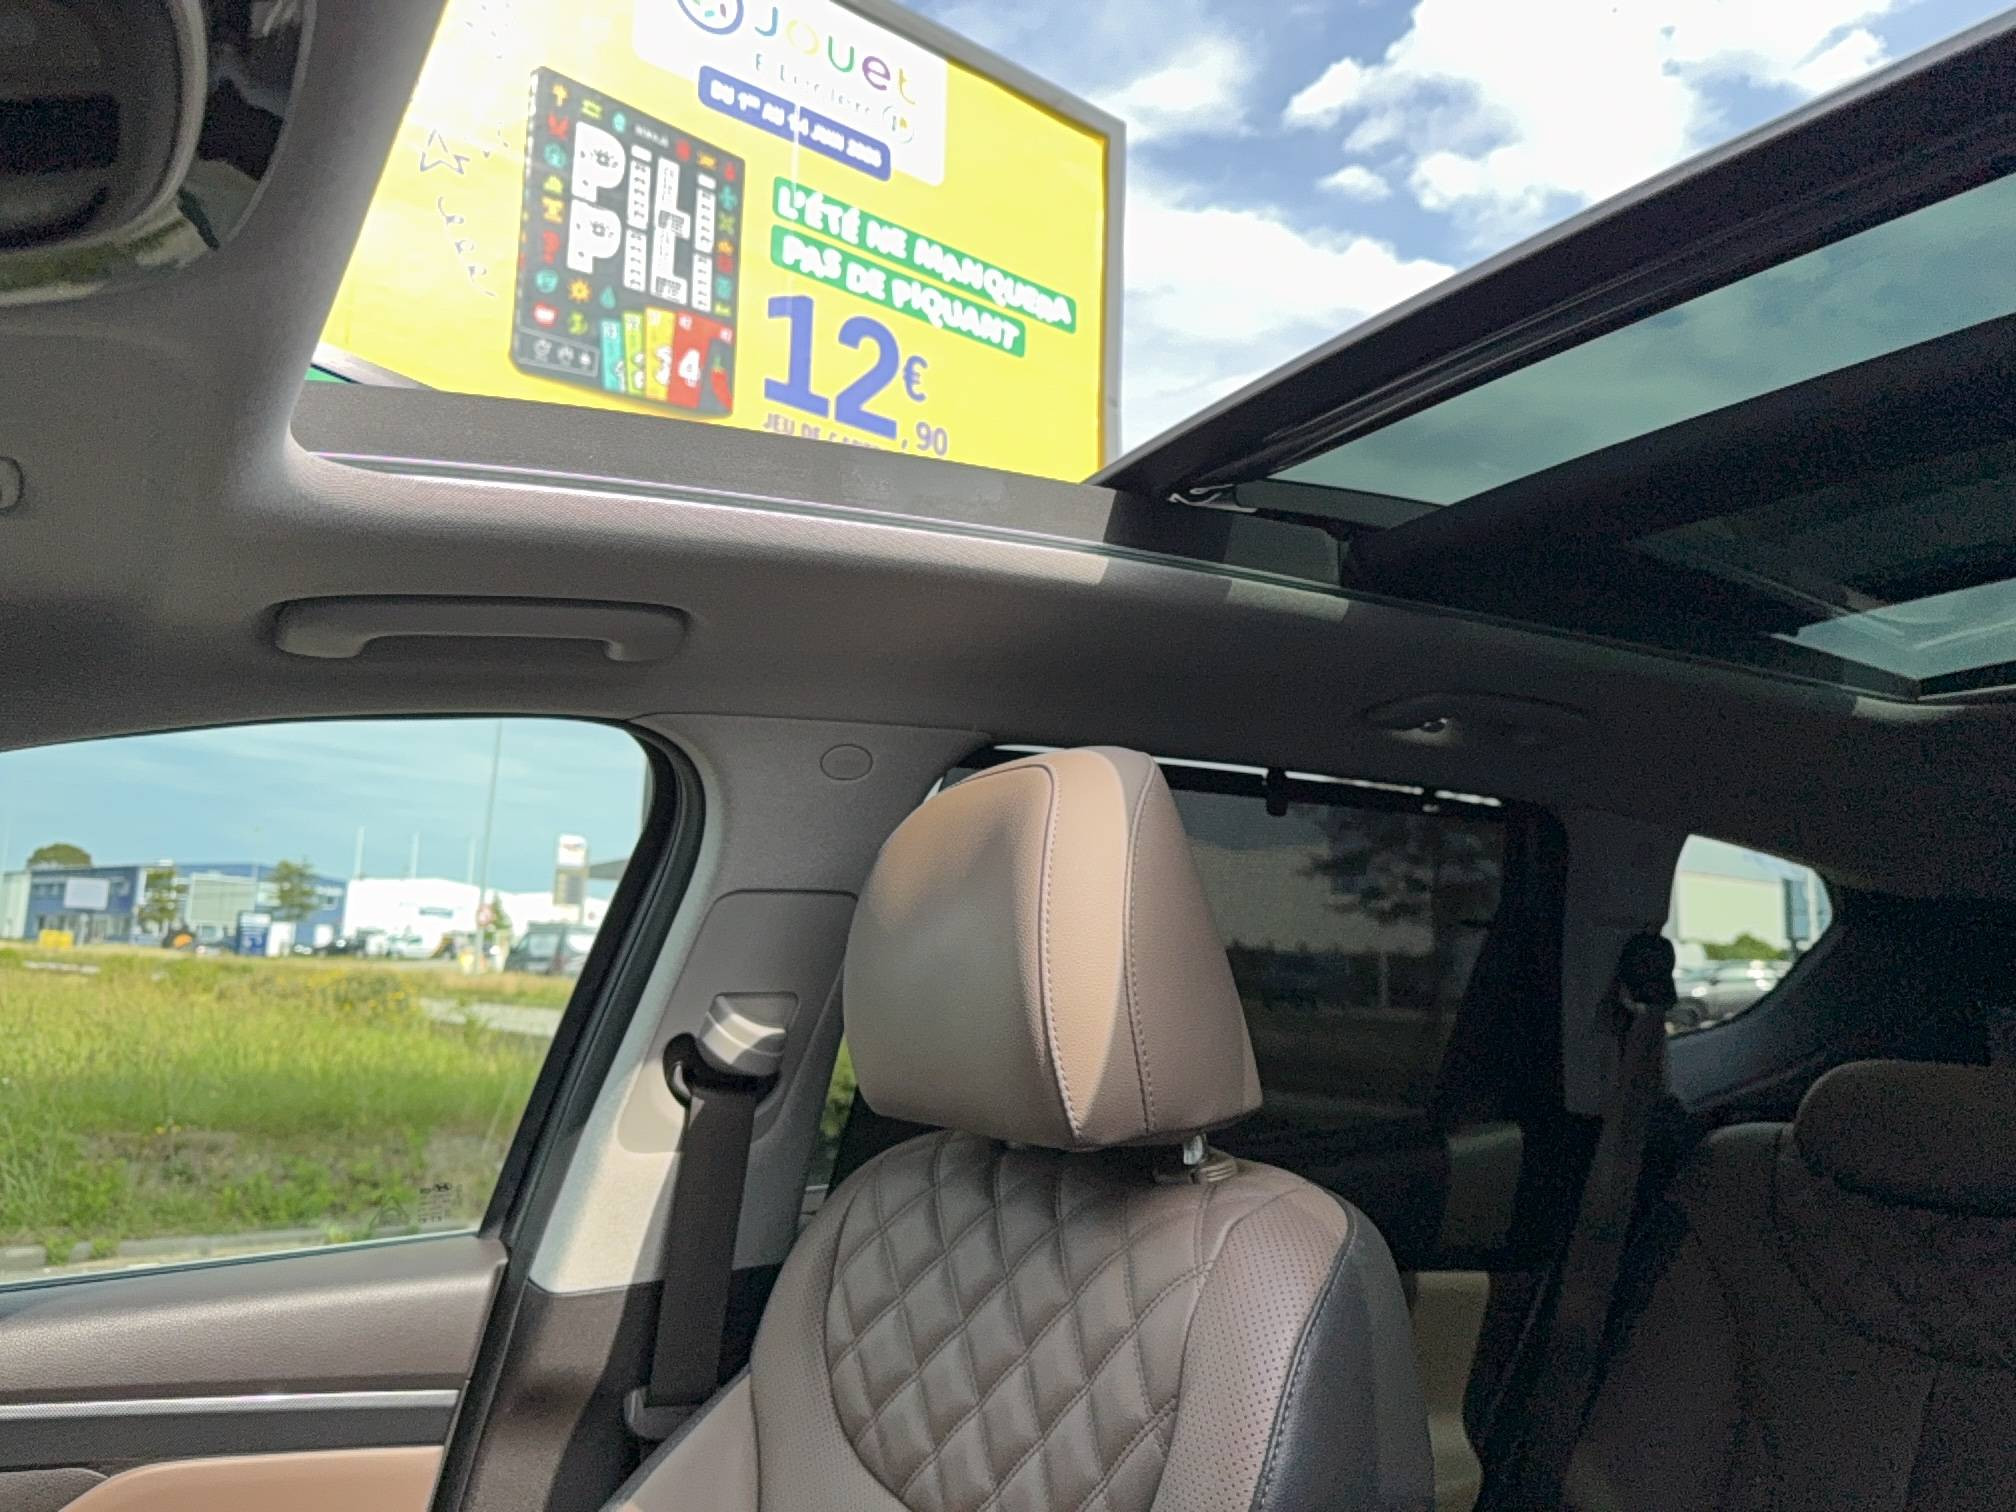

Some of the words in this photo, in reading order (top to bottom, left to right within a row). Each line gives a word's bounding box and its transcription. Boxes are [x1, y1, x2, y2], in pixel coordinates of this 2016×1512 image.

[866, 220, 908, 259] NE
[782, 234, 842, 279] PAS
[846, 261, 886, 300] DE
[891, 279, 1020, 350] PIQUANT
